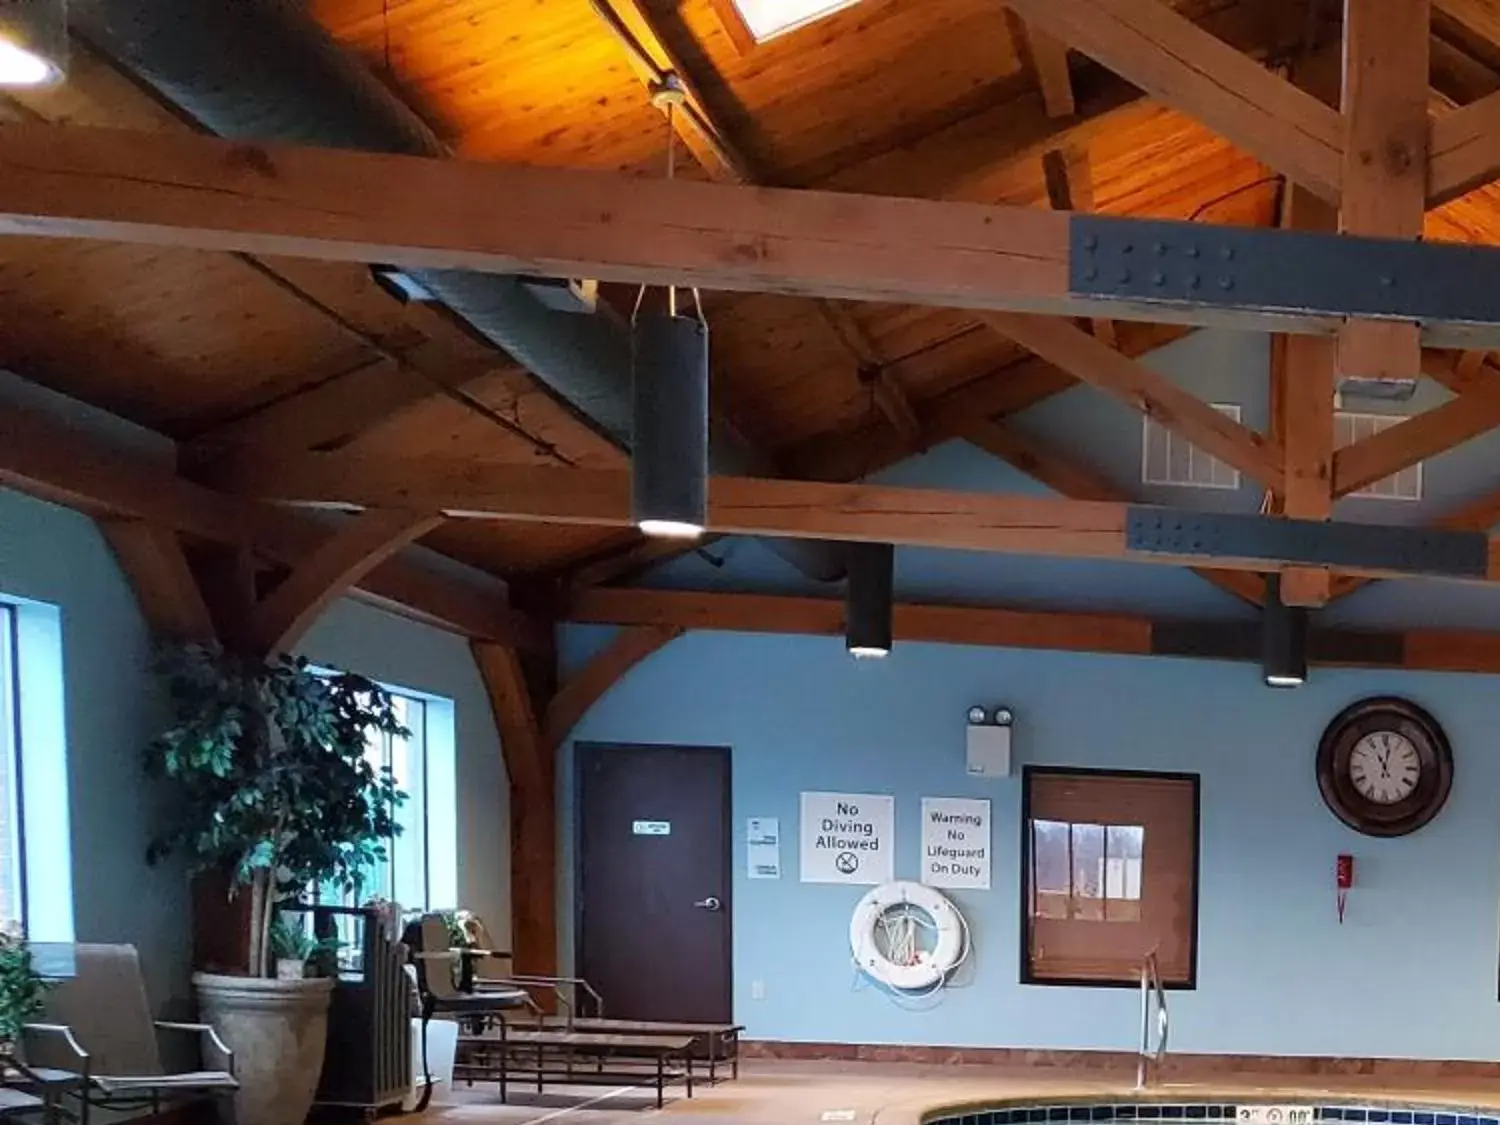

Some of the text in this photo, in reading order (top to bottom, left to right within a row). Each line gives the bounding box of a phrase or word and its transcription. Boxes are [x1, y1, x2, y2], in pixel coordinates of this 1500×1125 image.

[837, 803, 859, 816] No
[930, 812, 983, 827] Warning
[821, 819, 873, 836] Diving
[947, 829, 965, 841] No
[816, 835, 879, 850] Allowed
[927, 846, 985, 860] Lifeguard
[931, 863, 981, 877] On Duty
